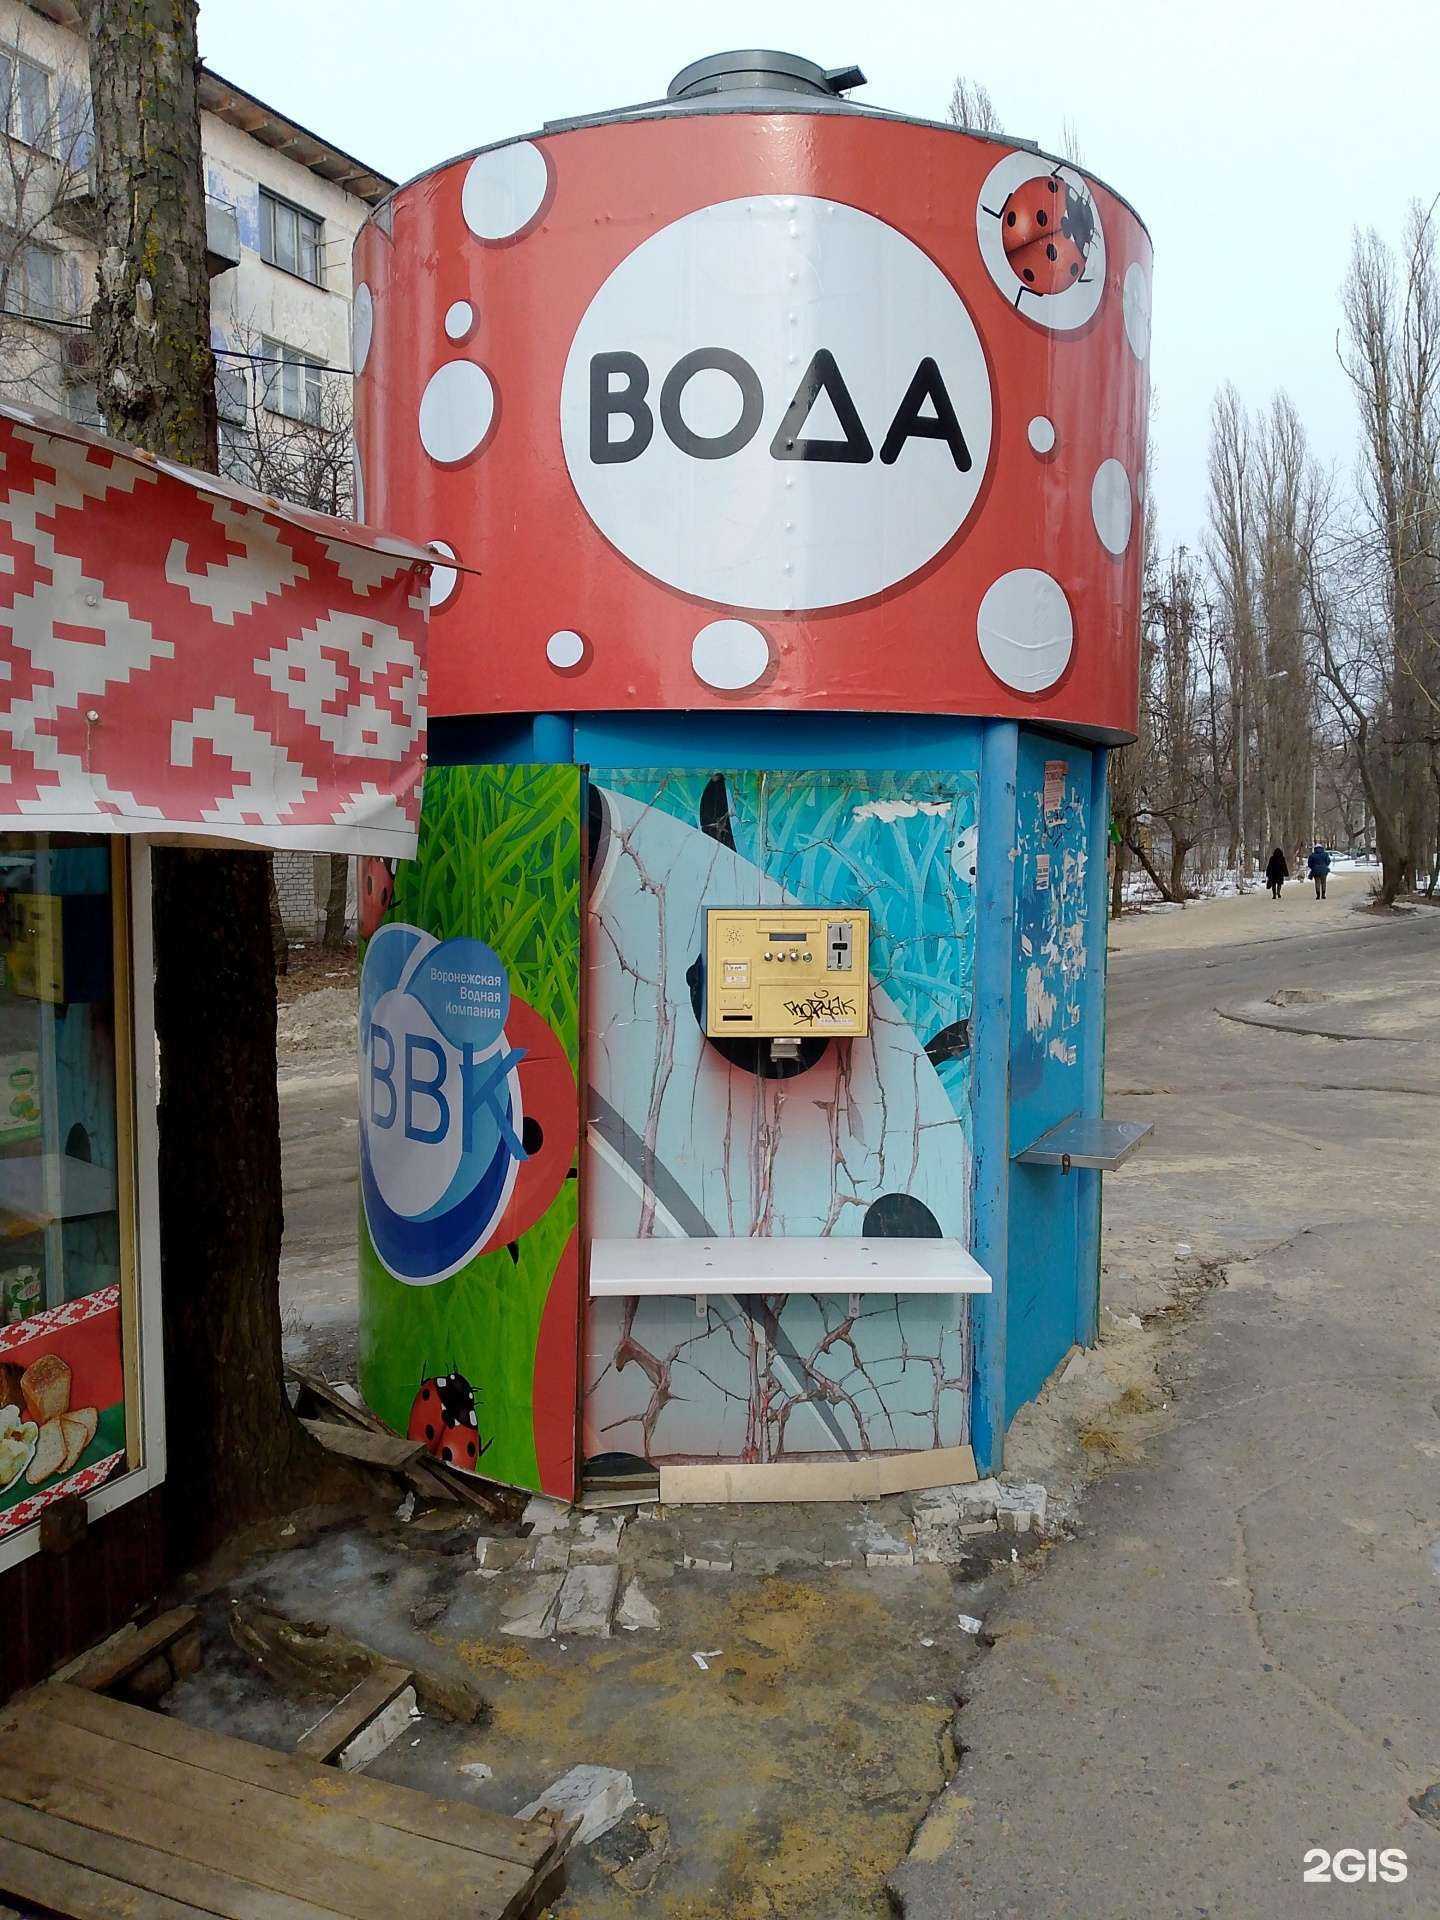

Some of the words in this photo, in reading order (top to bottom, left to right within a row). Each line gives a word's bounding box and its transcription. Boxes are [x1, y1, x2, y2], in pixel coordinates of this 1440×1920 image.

[588, 346, 973, 473] ВОДА
[430, 968, 502, 987] Воронежская
[460, 986, 501, 1003] Водная
[445, 1000, 501, 1019] Компания
